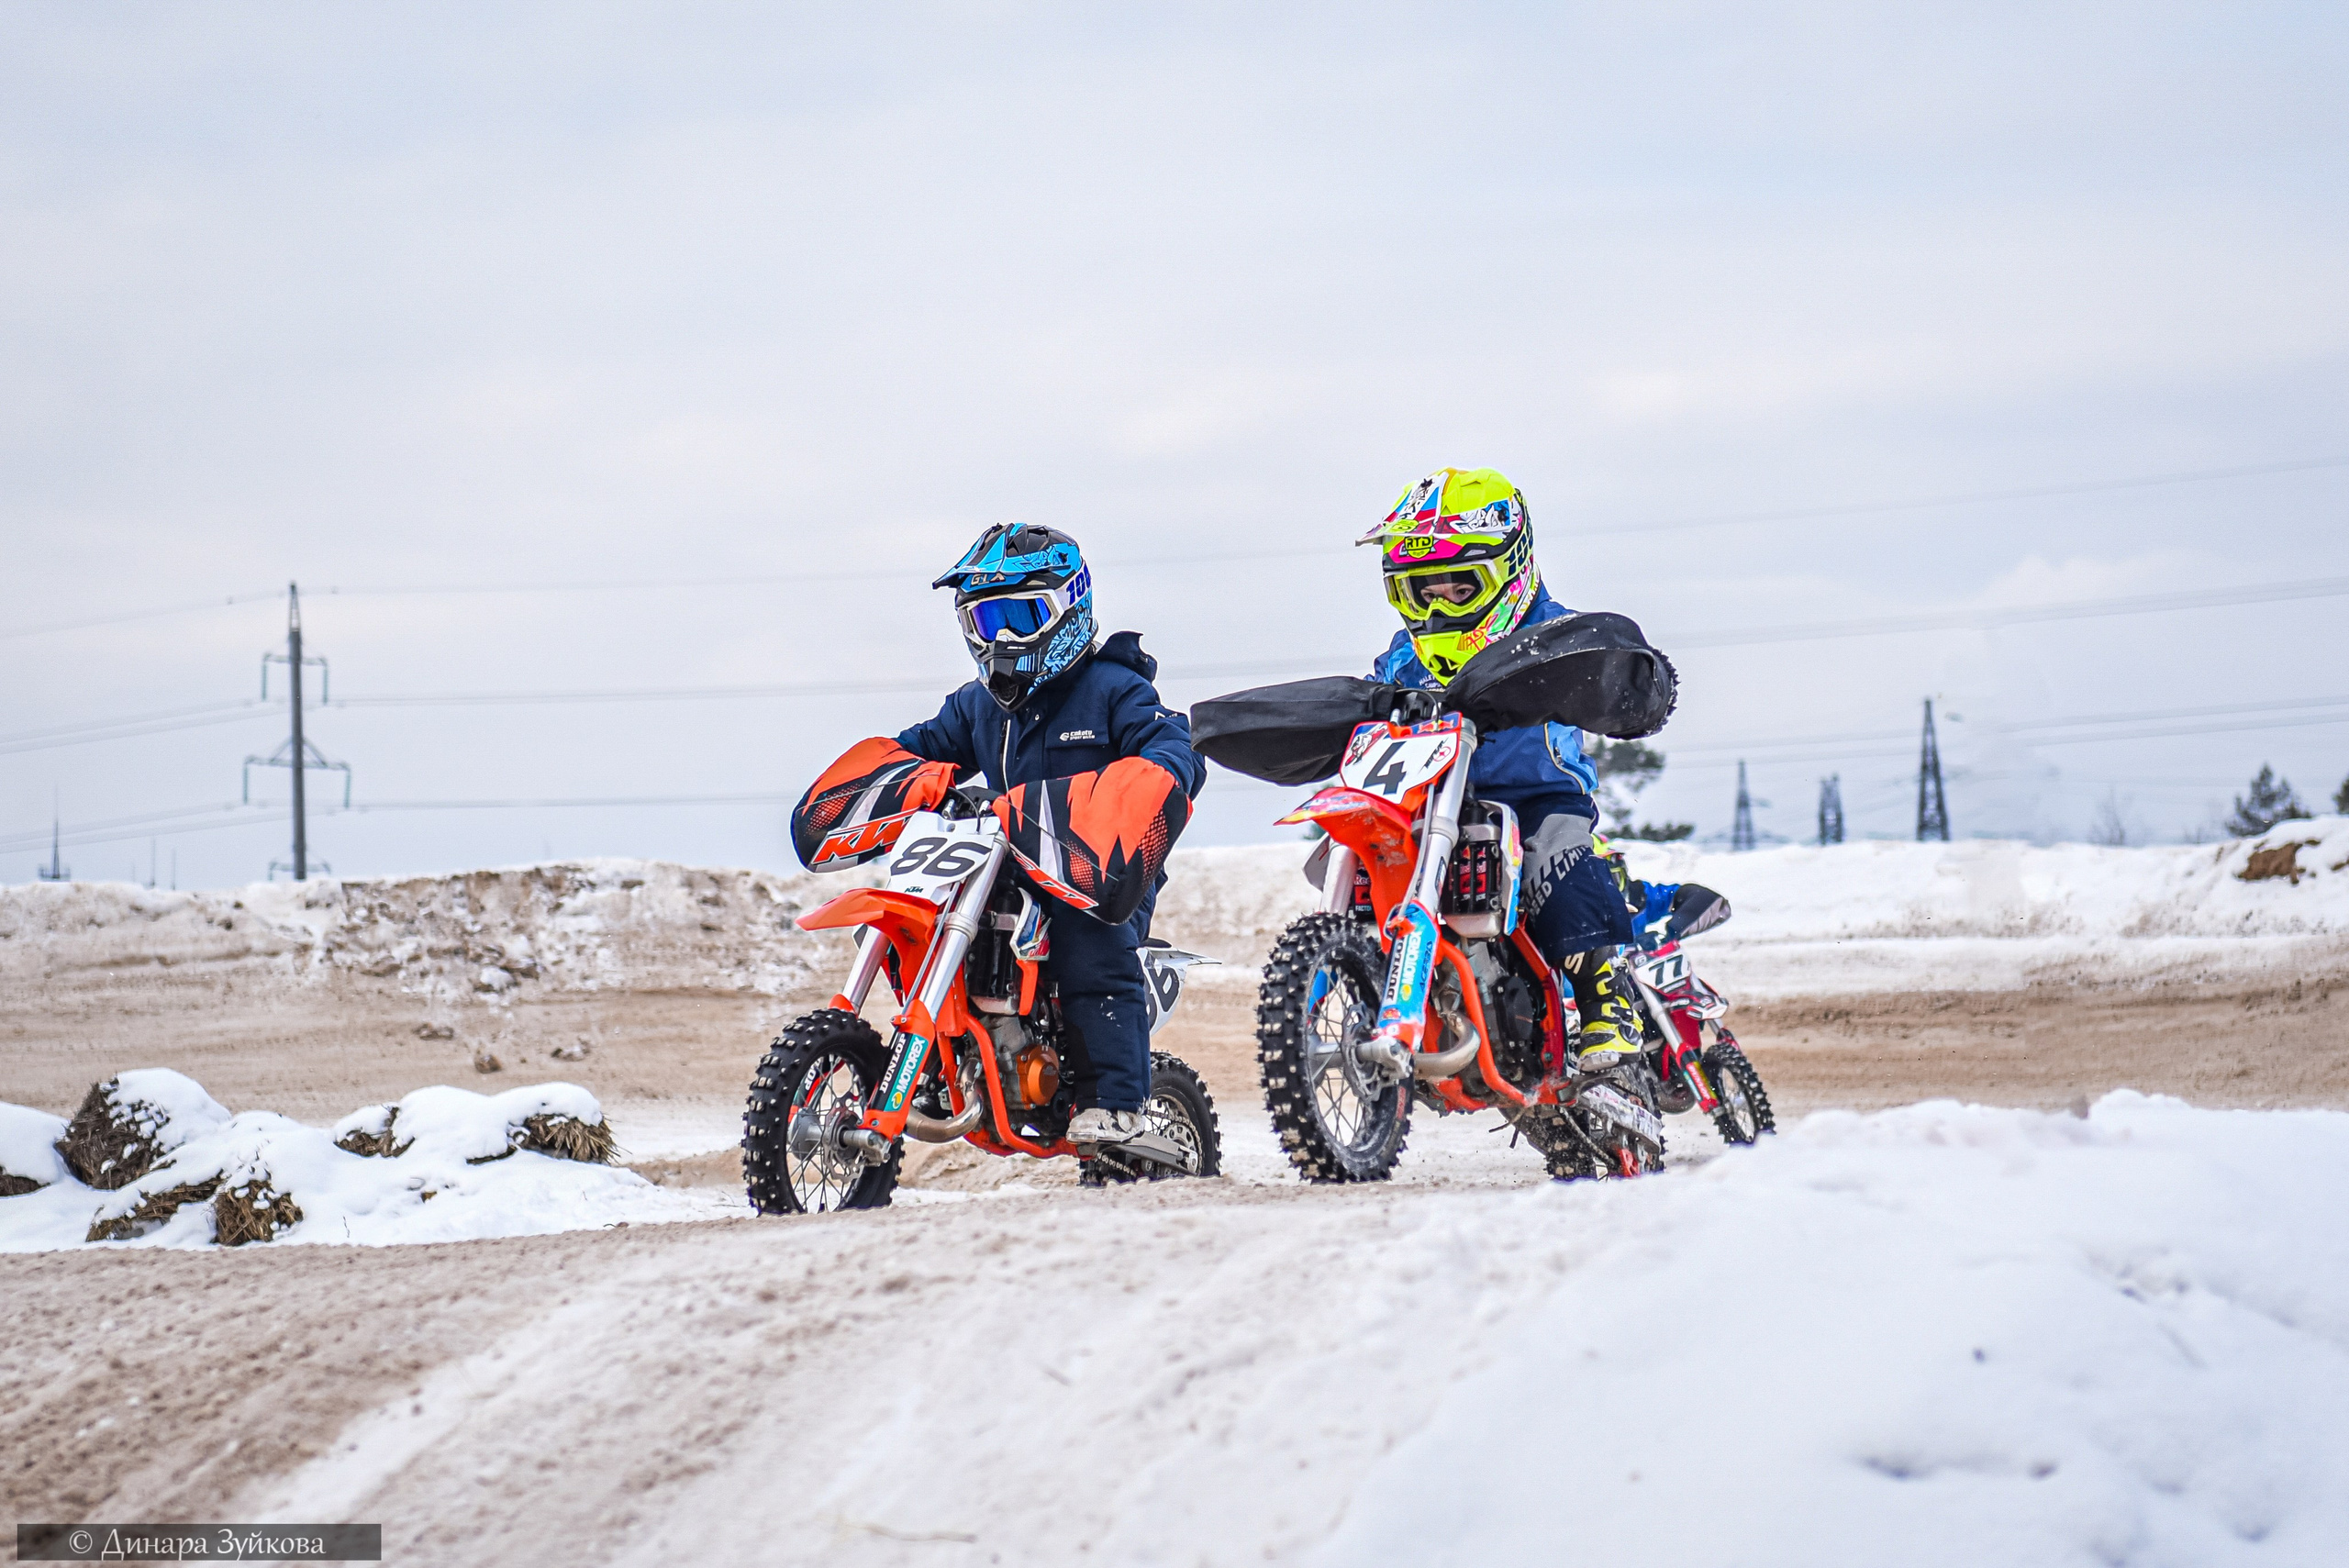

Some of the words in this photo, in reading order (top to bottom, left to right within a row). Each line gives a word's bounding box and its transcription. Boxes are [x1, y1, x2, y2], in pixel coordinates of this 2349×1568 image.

[1407, 537, 1431, 549] RTD
[1363, 740, 1408, 795] 4
[889, 837, 993, 877] 86
[1648, 954, 1684, 987] 77
[879, 1033, 907, 1094] DUNLOP
[896, 1036, 926, 1093] MOTOREX
